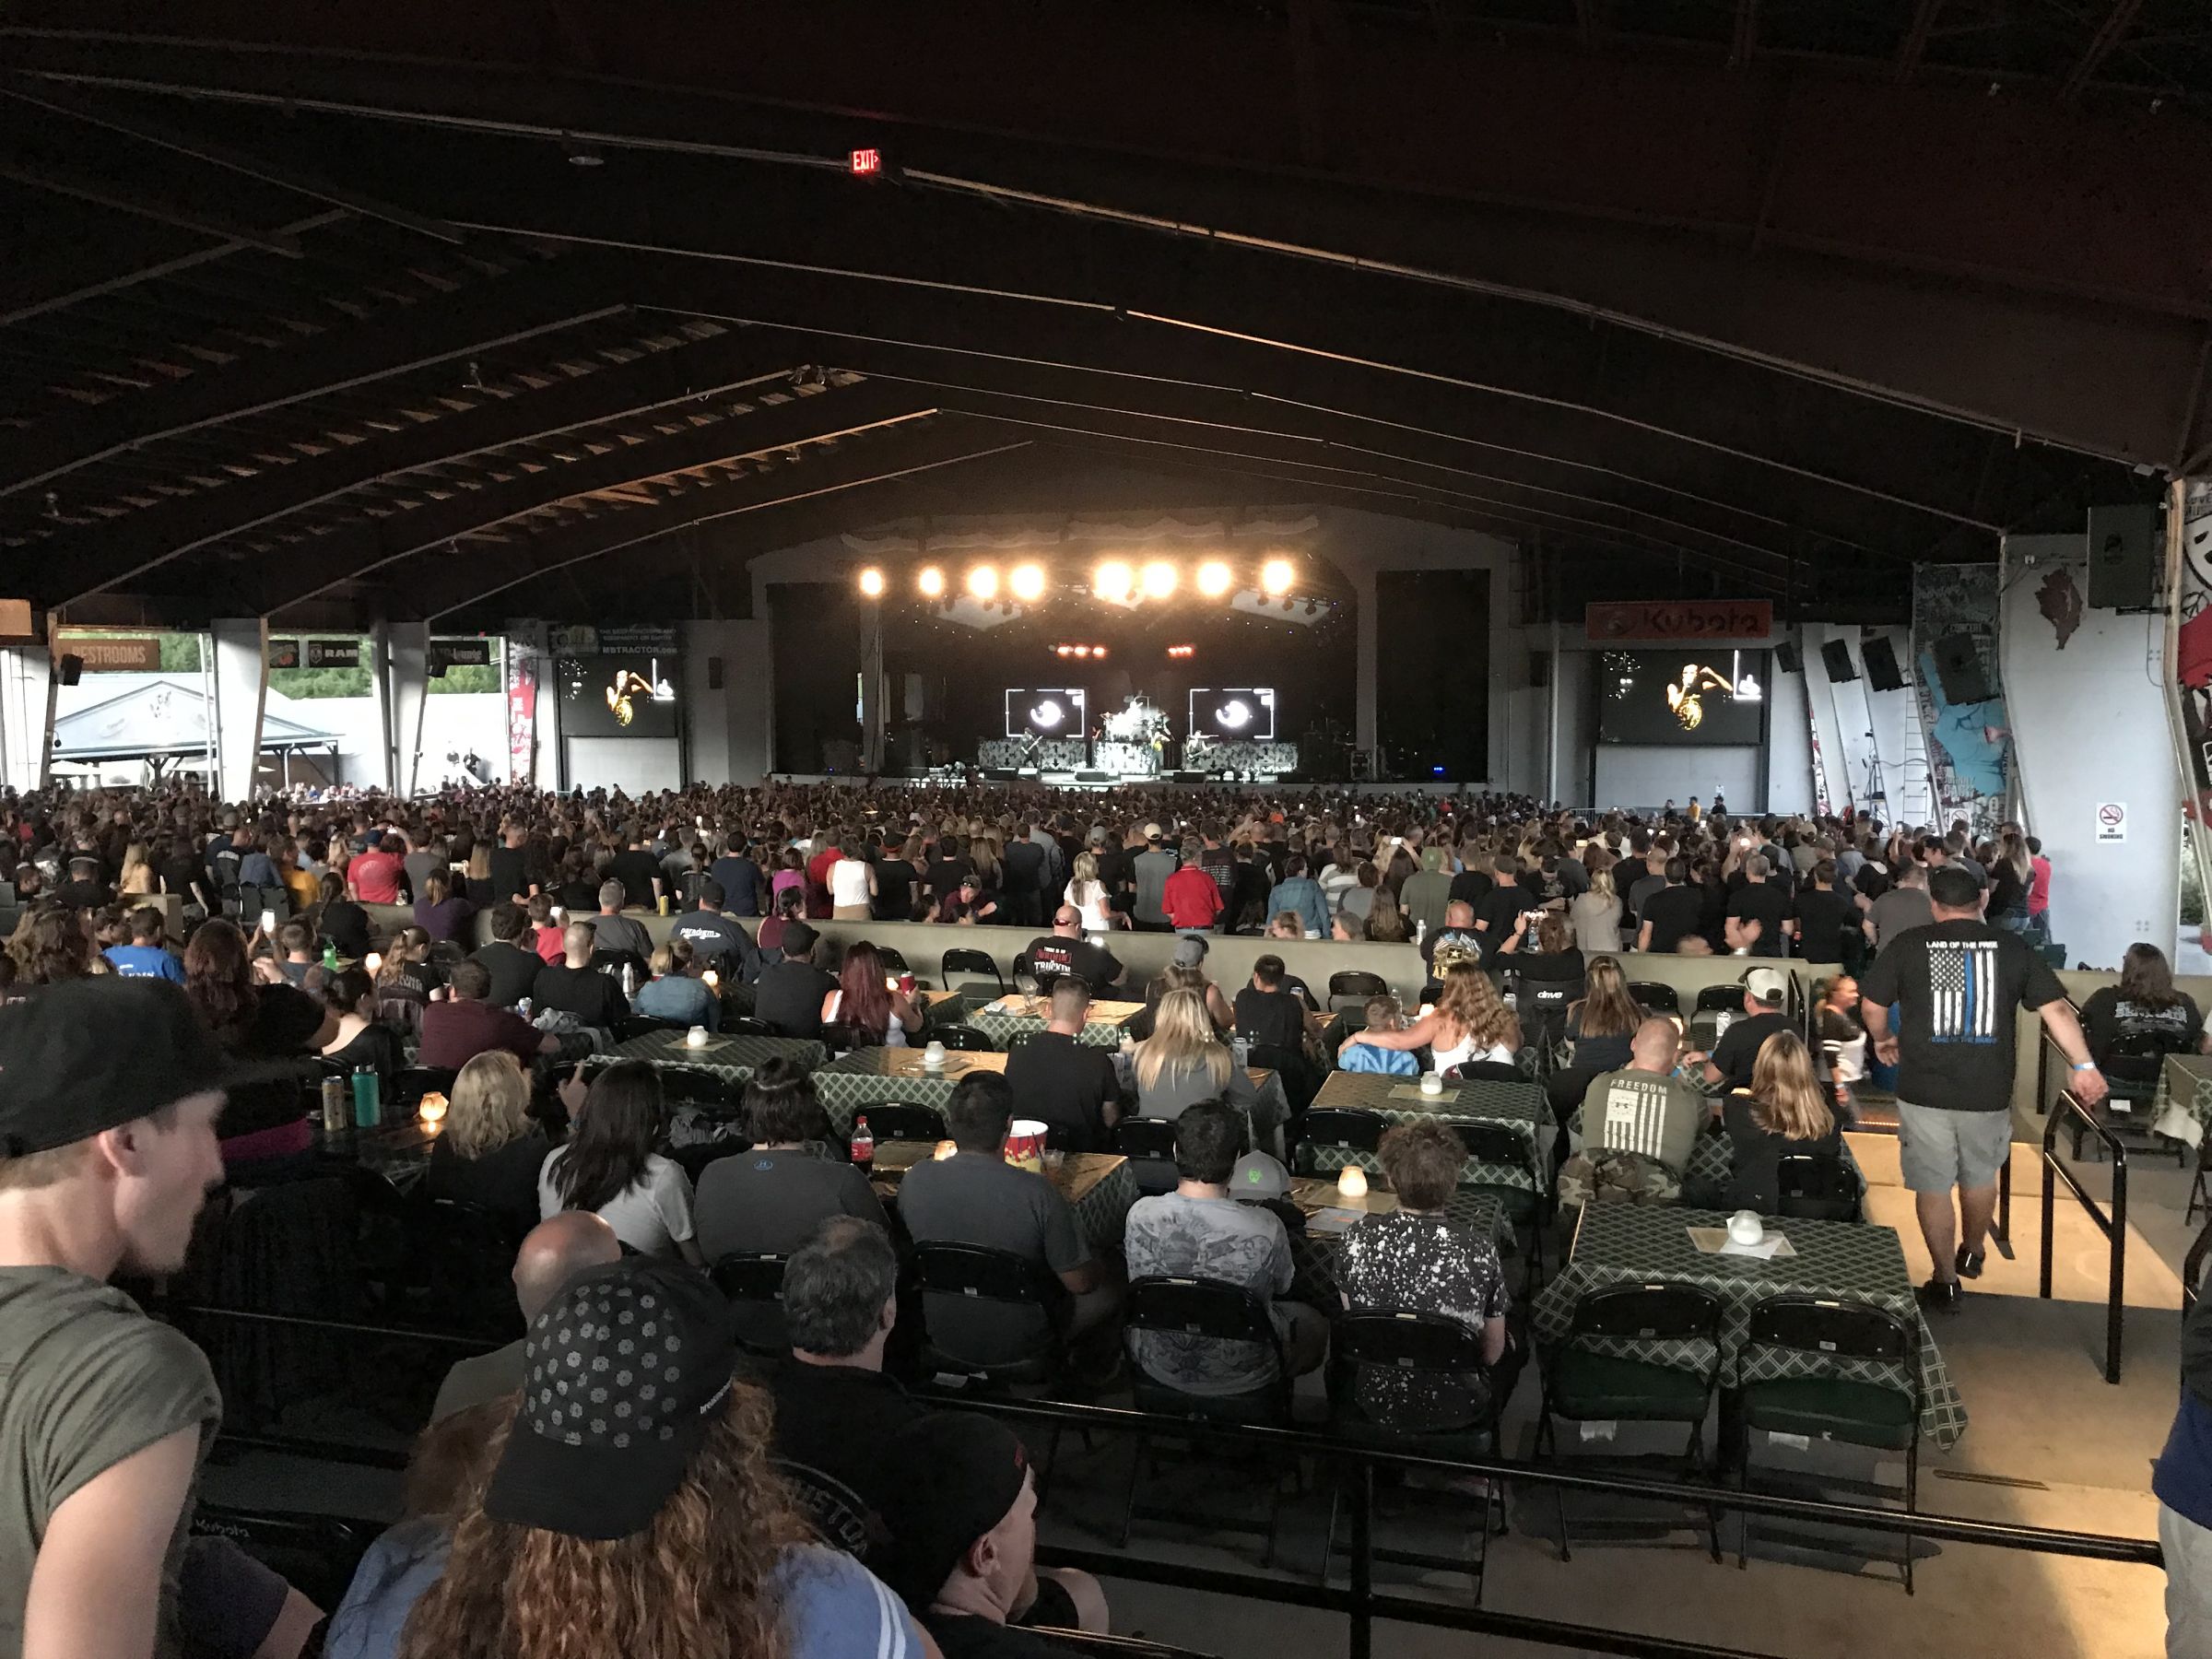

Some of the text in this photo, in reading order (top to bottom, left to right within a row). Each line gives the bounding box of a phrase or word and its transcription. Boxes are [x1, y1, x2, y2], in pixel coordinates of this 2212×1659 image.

[853, 149, 875, 171] EXIT
[1643, 607, 1759, 633] Kubota
[324, 649, 358, 658] RAM
[1537, 991, 1563, 999] drive
[1610, 1078, 1667, 1095] FREEDOM
